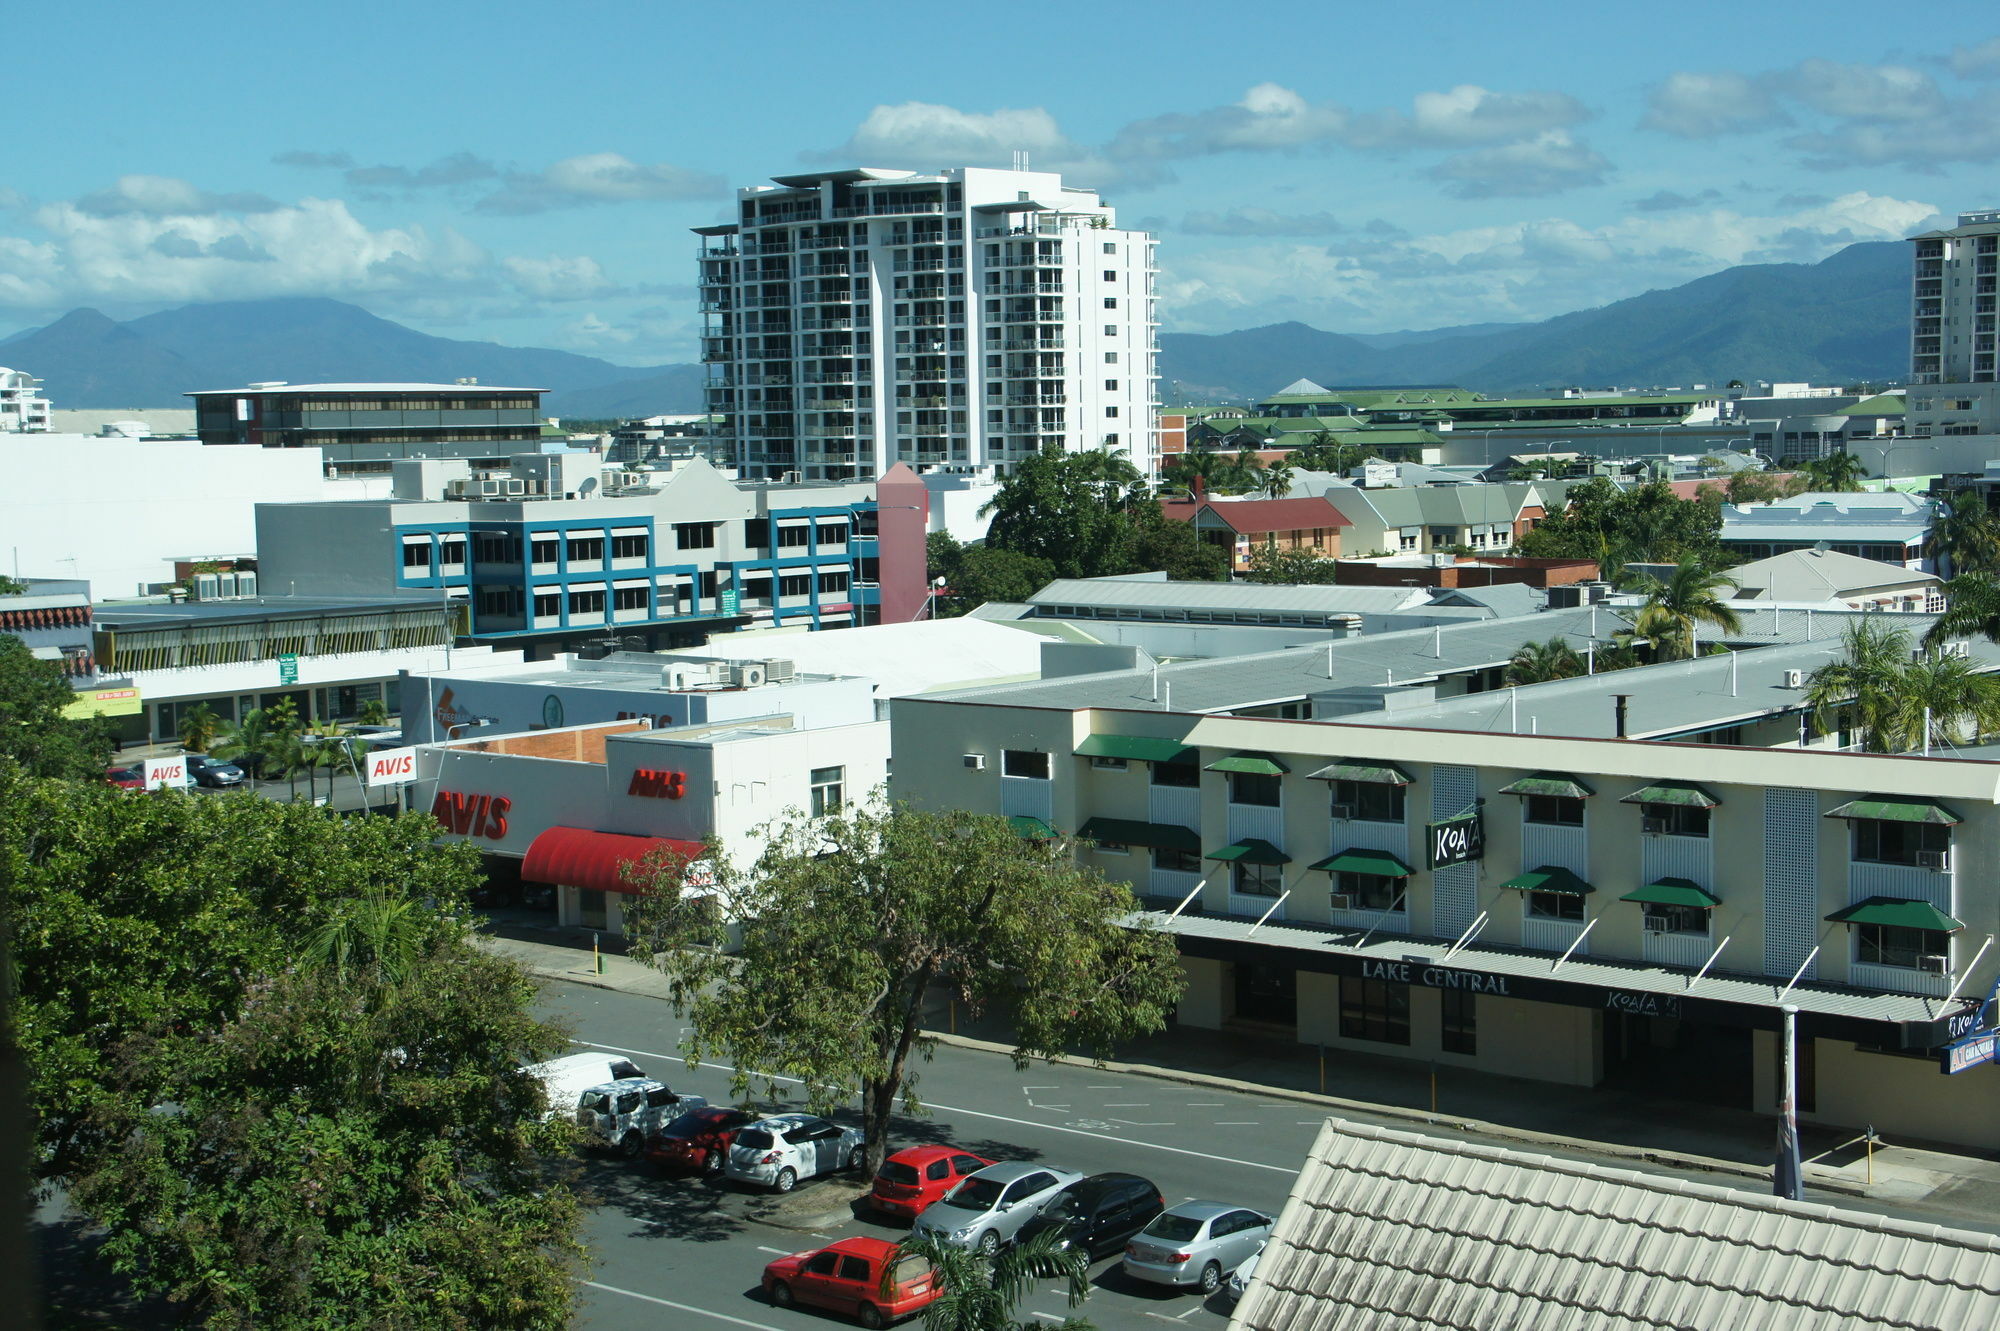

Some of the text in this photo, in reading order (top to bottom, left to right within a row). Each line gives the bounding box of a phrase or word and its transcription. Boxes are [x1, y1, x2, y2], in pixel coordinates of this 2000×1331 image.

[151, 766, 182, 781] AVIS
[374, 756, 412, 777] AVIS
[628, 769, 687, 800] AVIS
[431, 791, 511, 840] AVIS
[1362, 960, 1510, 995] LAKE CENTRAL
[1952, 1046, 1966, 1066] A1
